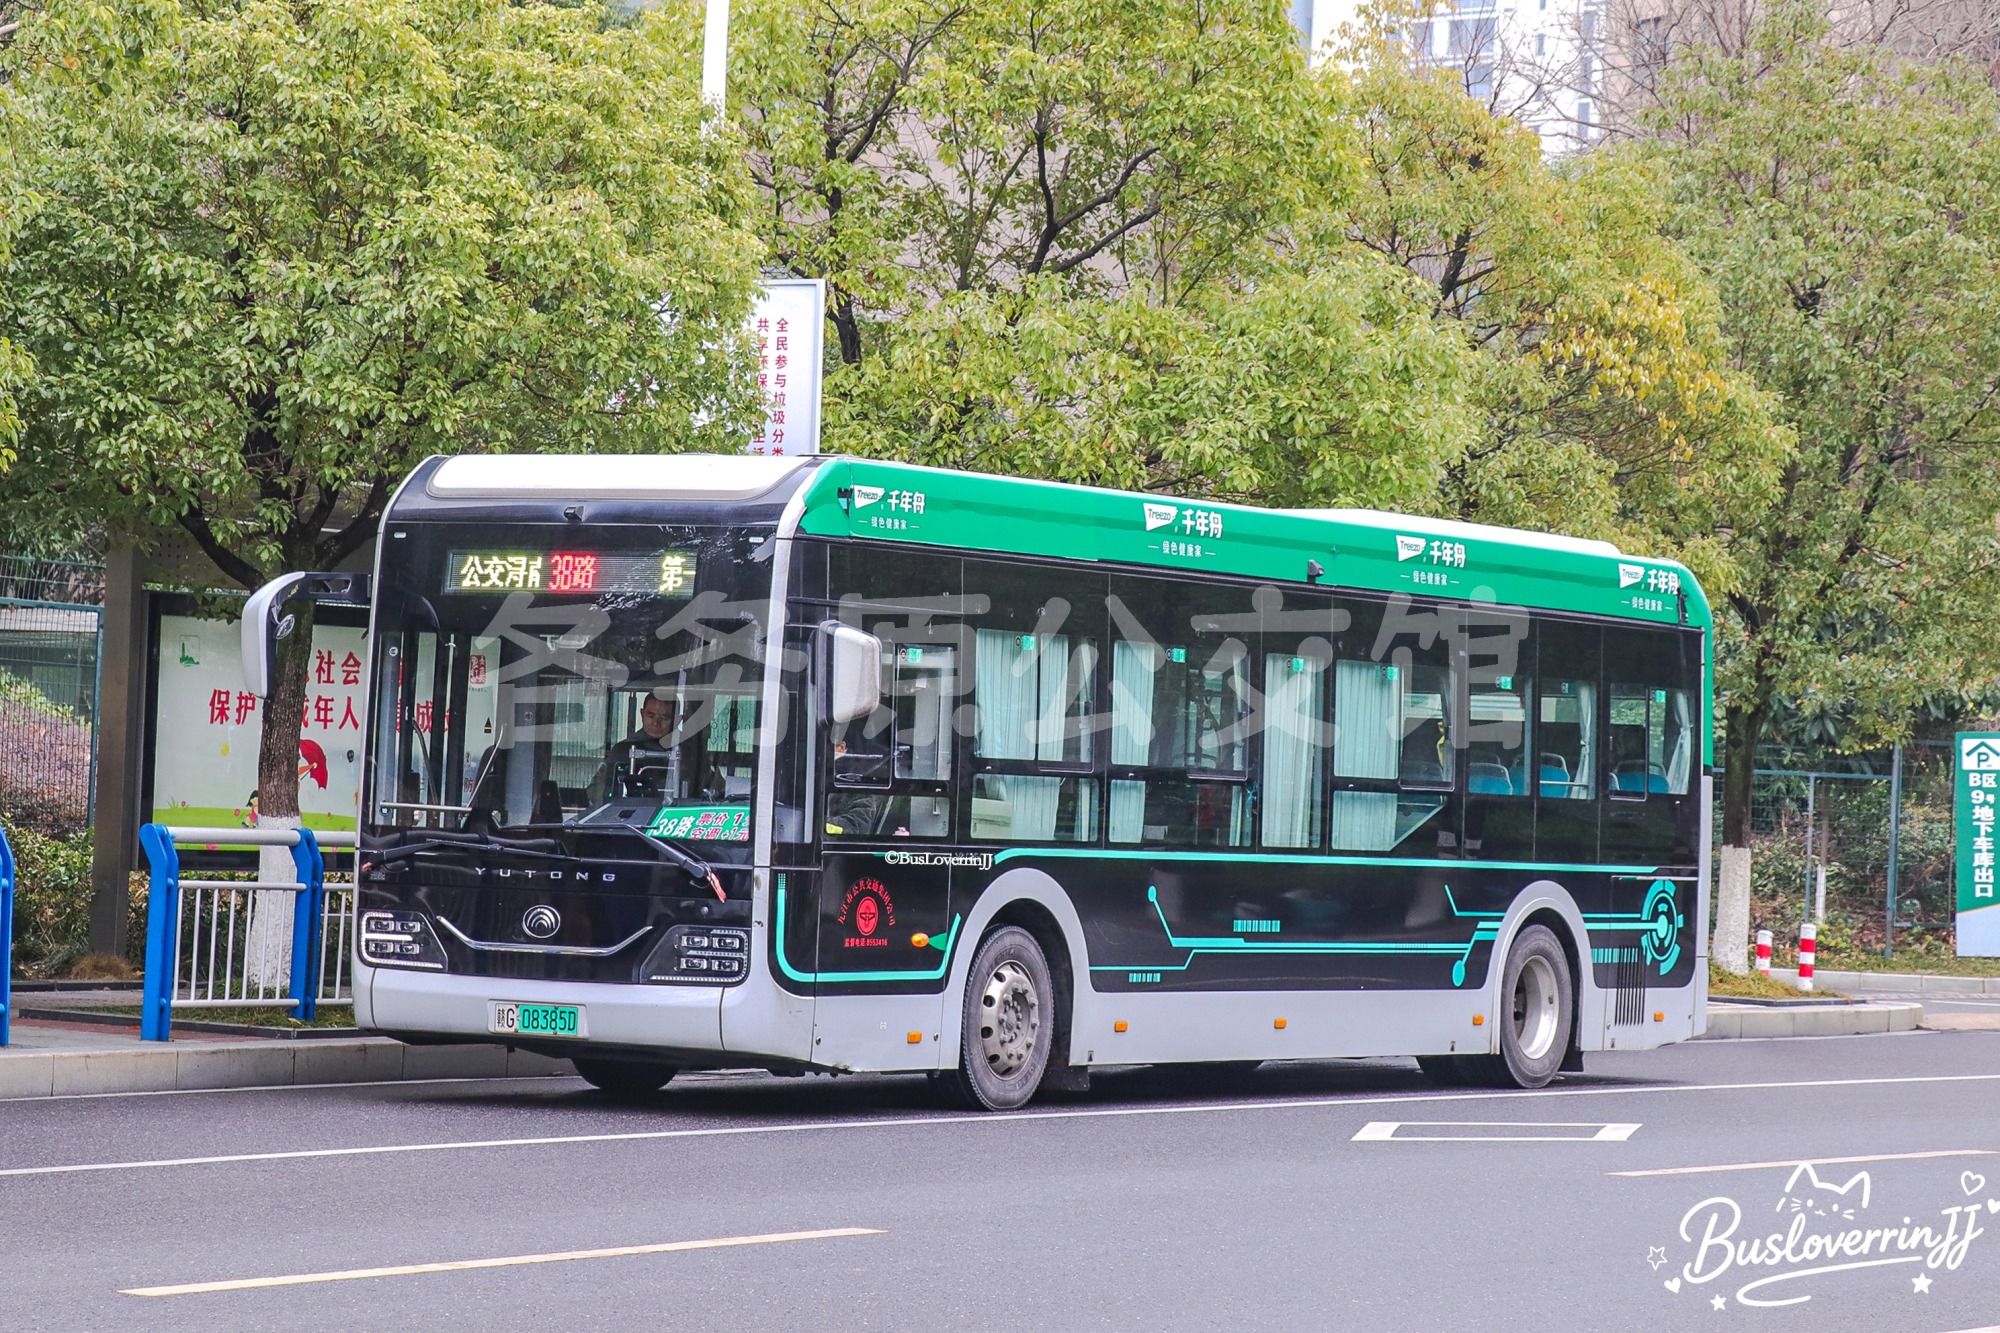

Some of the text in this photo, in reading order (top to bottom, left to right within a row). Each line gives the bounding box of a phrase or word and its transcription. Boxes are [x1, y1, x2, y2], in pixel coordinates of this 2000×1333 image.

[857, 491, 879, 501] Treezo
[887, 489, 926, 514] 千年舟
[1148, 508, 1172, 521] Treezo
[871, 516, 908, 530] 绿色健康家
[1182, 508, 1223, 538] 千年舟
[1162, 540, 1203, 557] 绿色健康家
[1400, 540, 1422, 552] Treezo
[1430, 540, 1467, 568] 千年舟
[549, 553, 596, 590] 38路
[1413, 570, 1448, 586] 绿色健康家
[304, 650, 361, 685] 社会
[1968, 772, 1998, 788] B区
[1971, 790, 1996, 805] 9号
[654, 816, 695, 837] 38路
[1972, 805, 1996, 898] 地下车库出口
[475, 867, 616, 882] YUTONG
